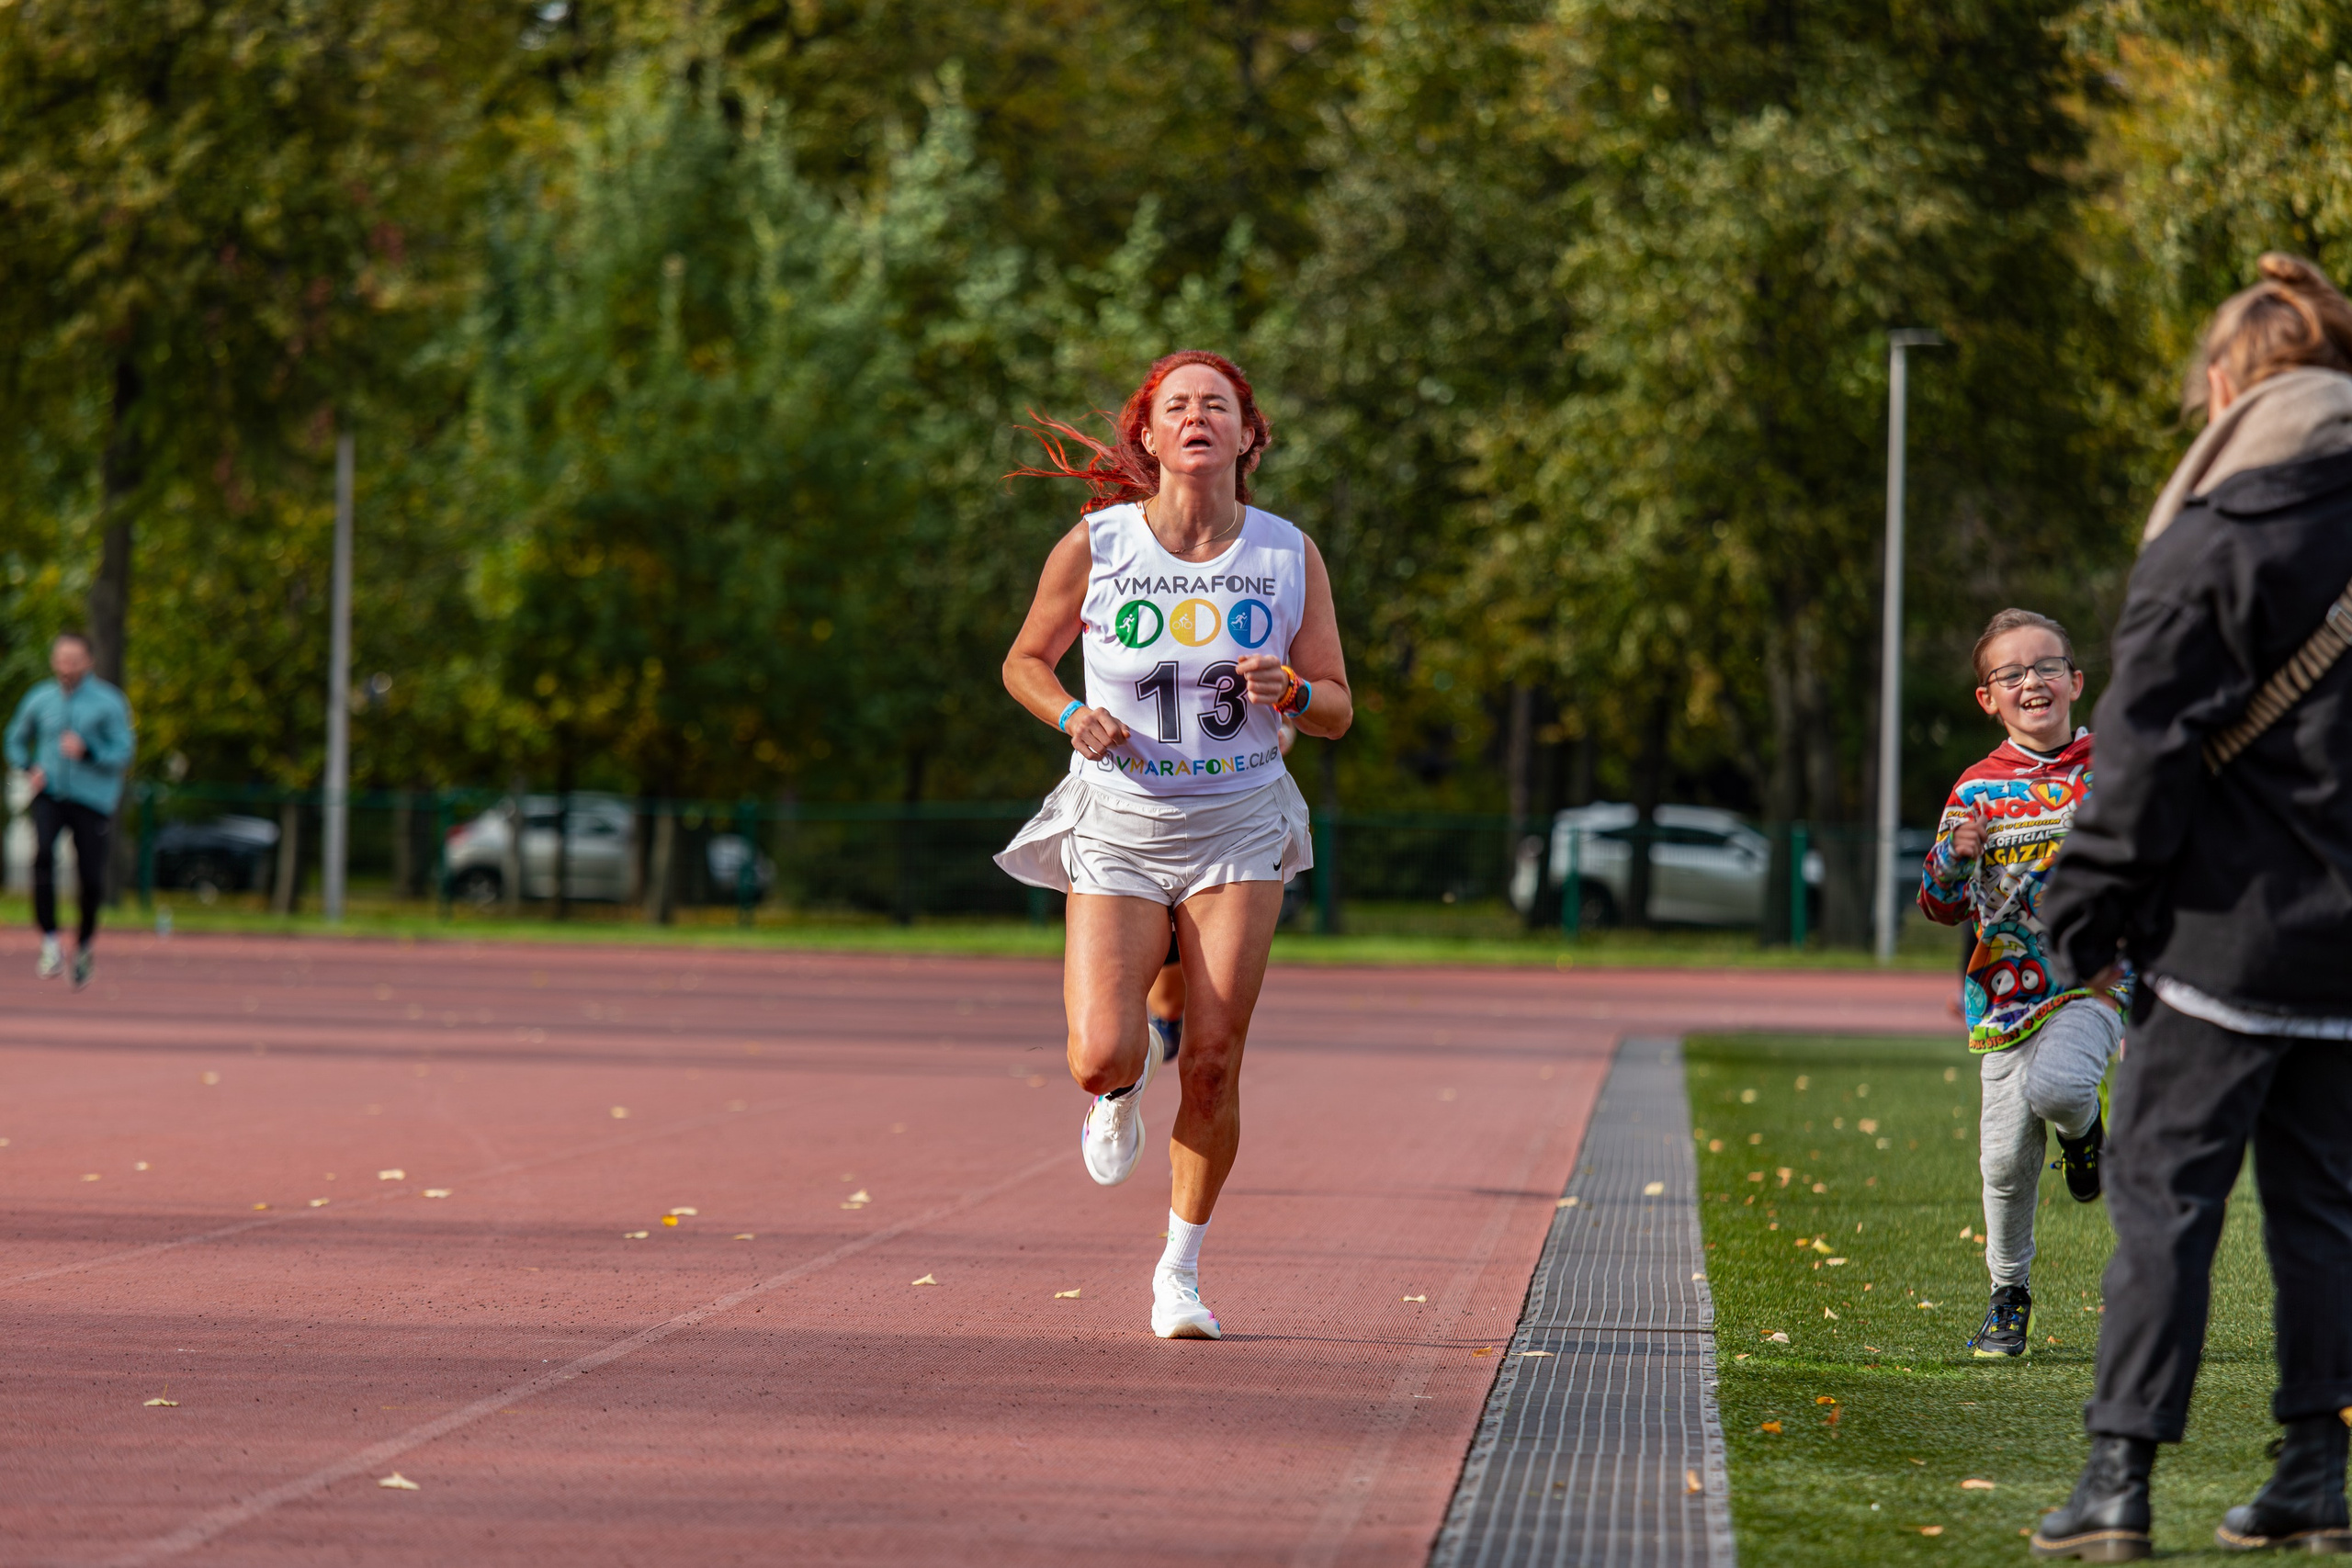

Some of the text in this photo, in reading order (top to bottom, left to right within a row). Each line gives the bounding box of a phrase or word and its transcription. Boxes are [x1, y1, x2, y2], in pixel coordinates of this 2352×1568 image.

[1114, 575, 1276, 596] VMARAFONE
[1135, 660, 1249, 744] 13
[1115, 745, 1279, 777] VMARAFONE.CLUB
[2014, 818, 2062, 829] KABOOM
[1996, 830, 2052, 848] OFFICIAL
